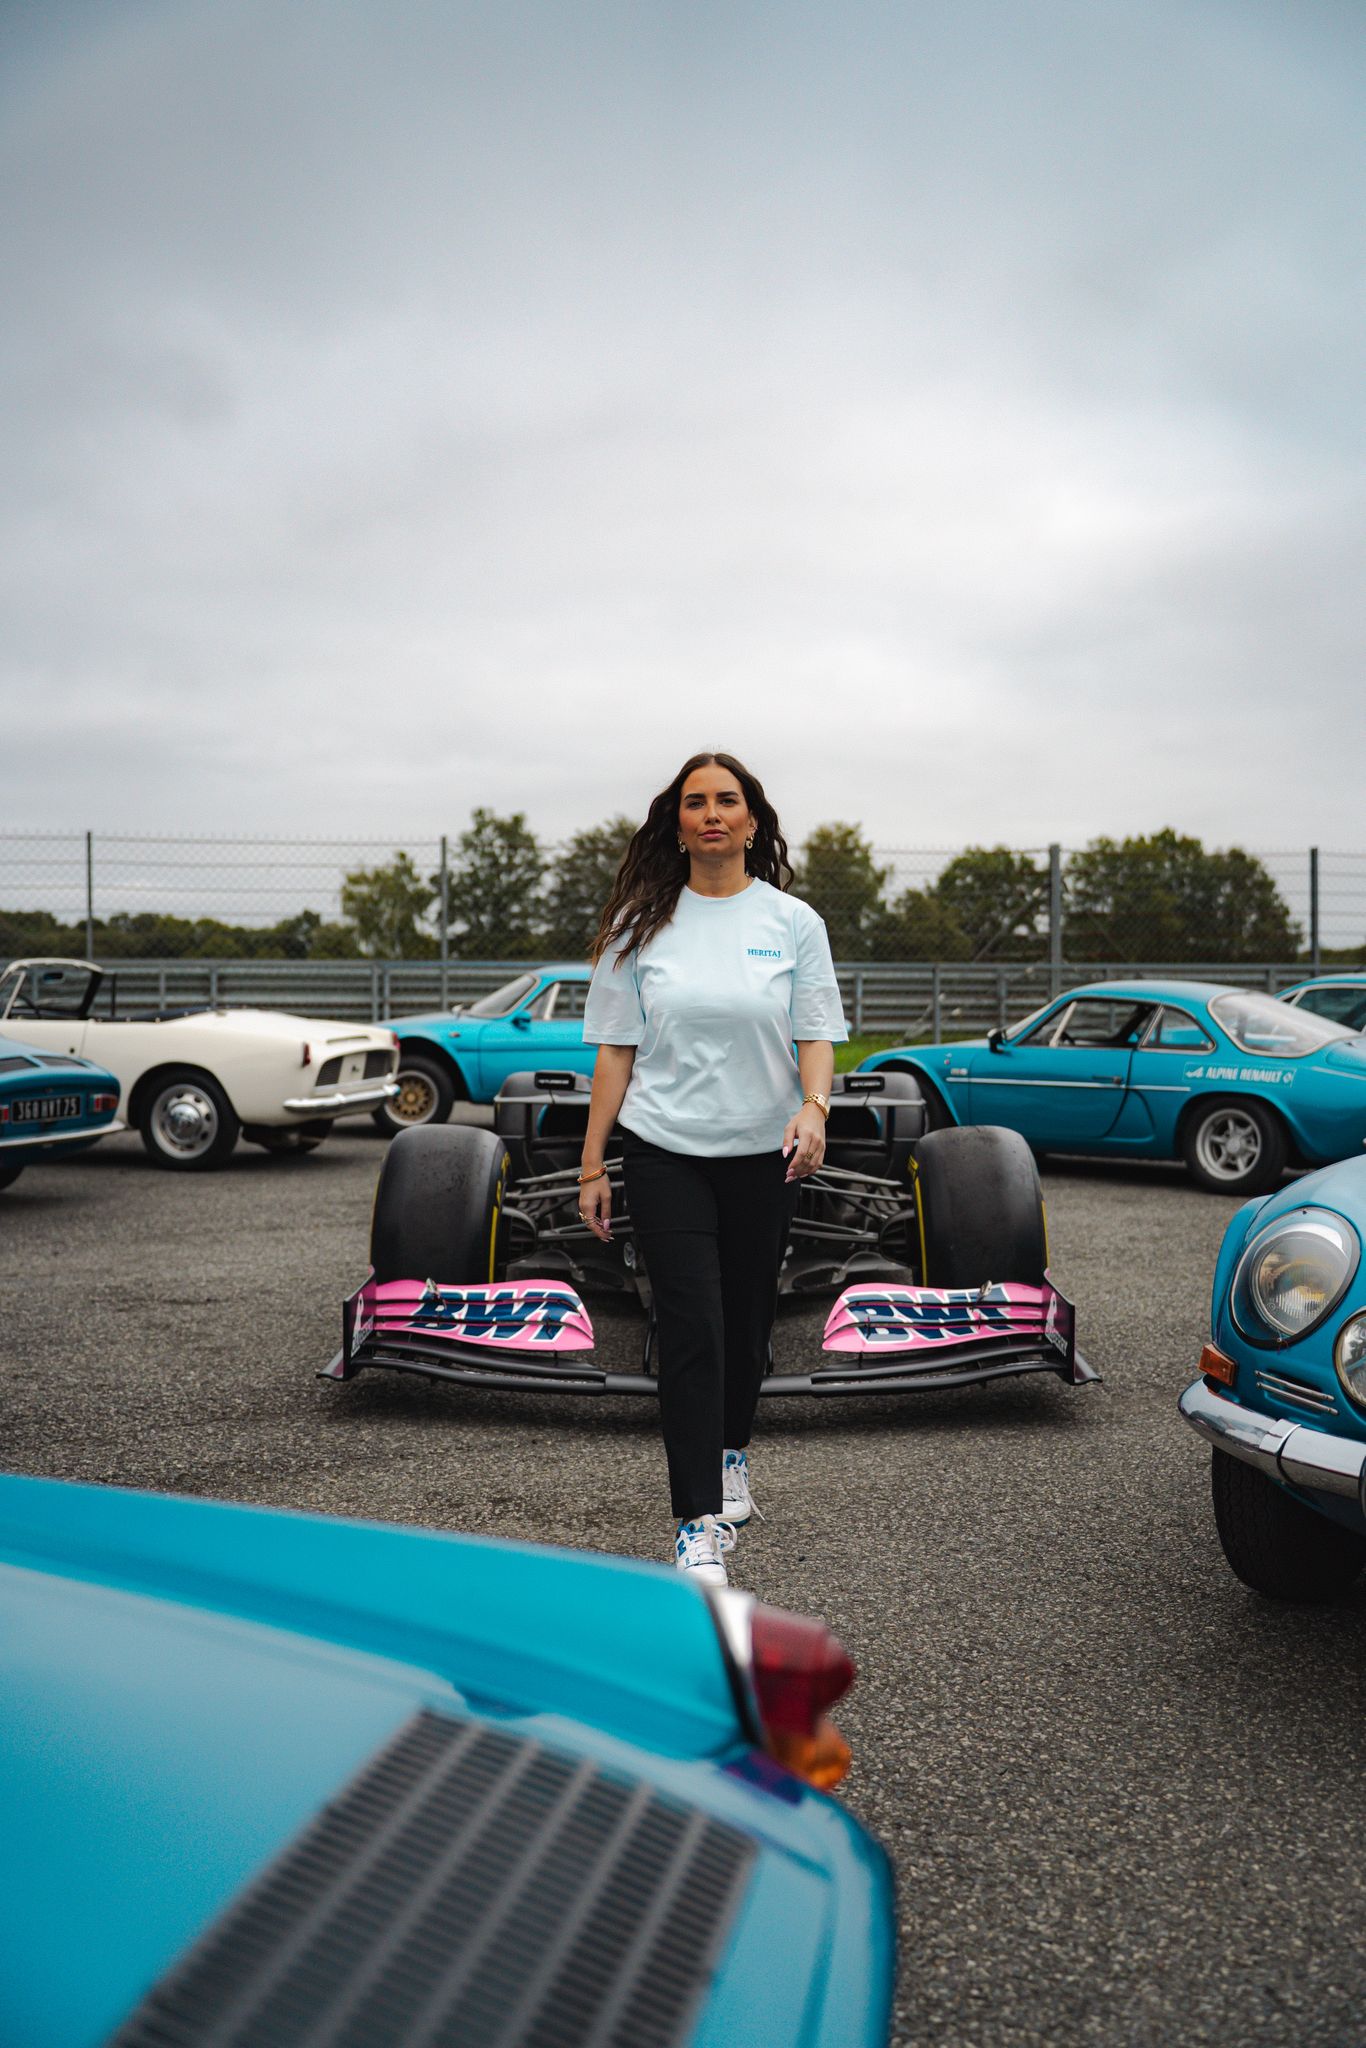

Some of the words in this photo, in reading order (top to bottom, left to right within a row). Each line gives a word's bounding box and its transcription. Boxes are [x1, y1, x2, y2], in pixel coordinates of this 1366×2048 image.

[747, 948, 781, 958] HERITAJ
[1205, 1066, 1239, 1081] ALPINE
[1239, 1068, 1283, 1083] RENAULT
[404, 1288, 584, 1342] BWT
[841, 1284, 1018, 1345] BWT
